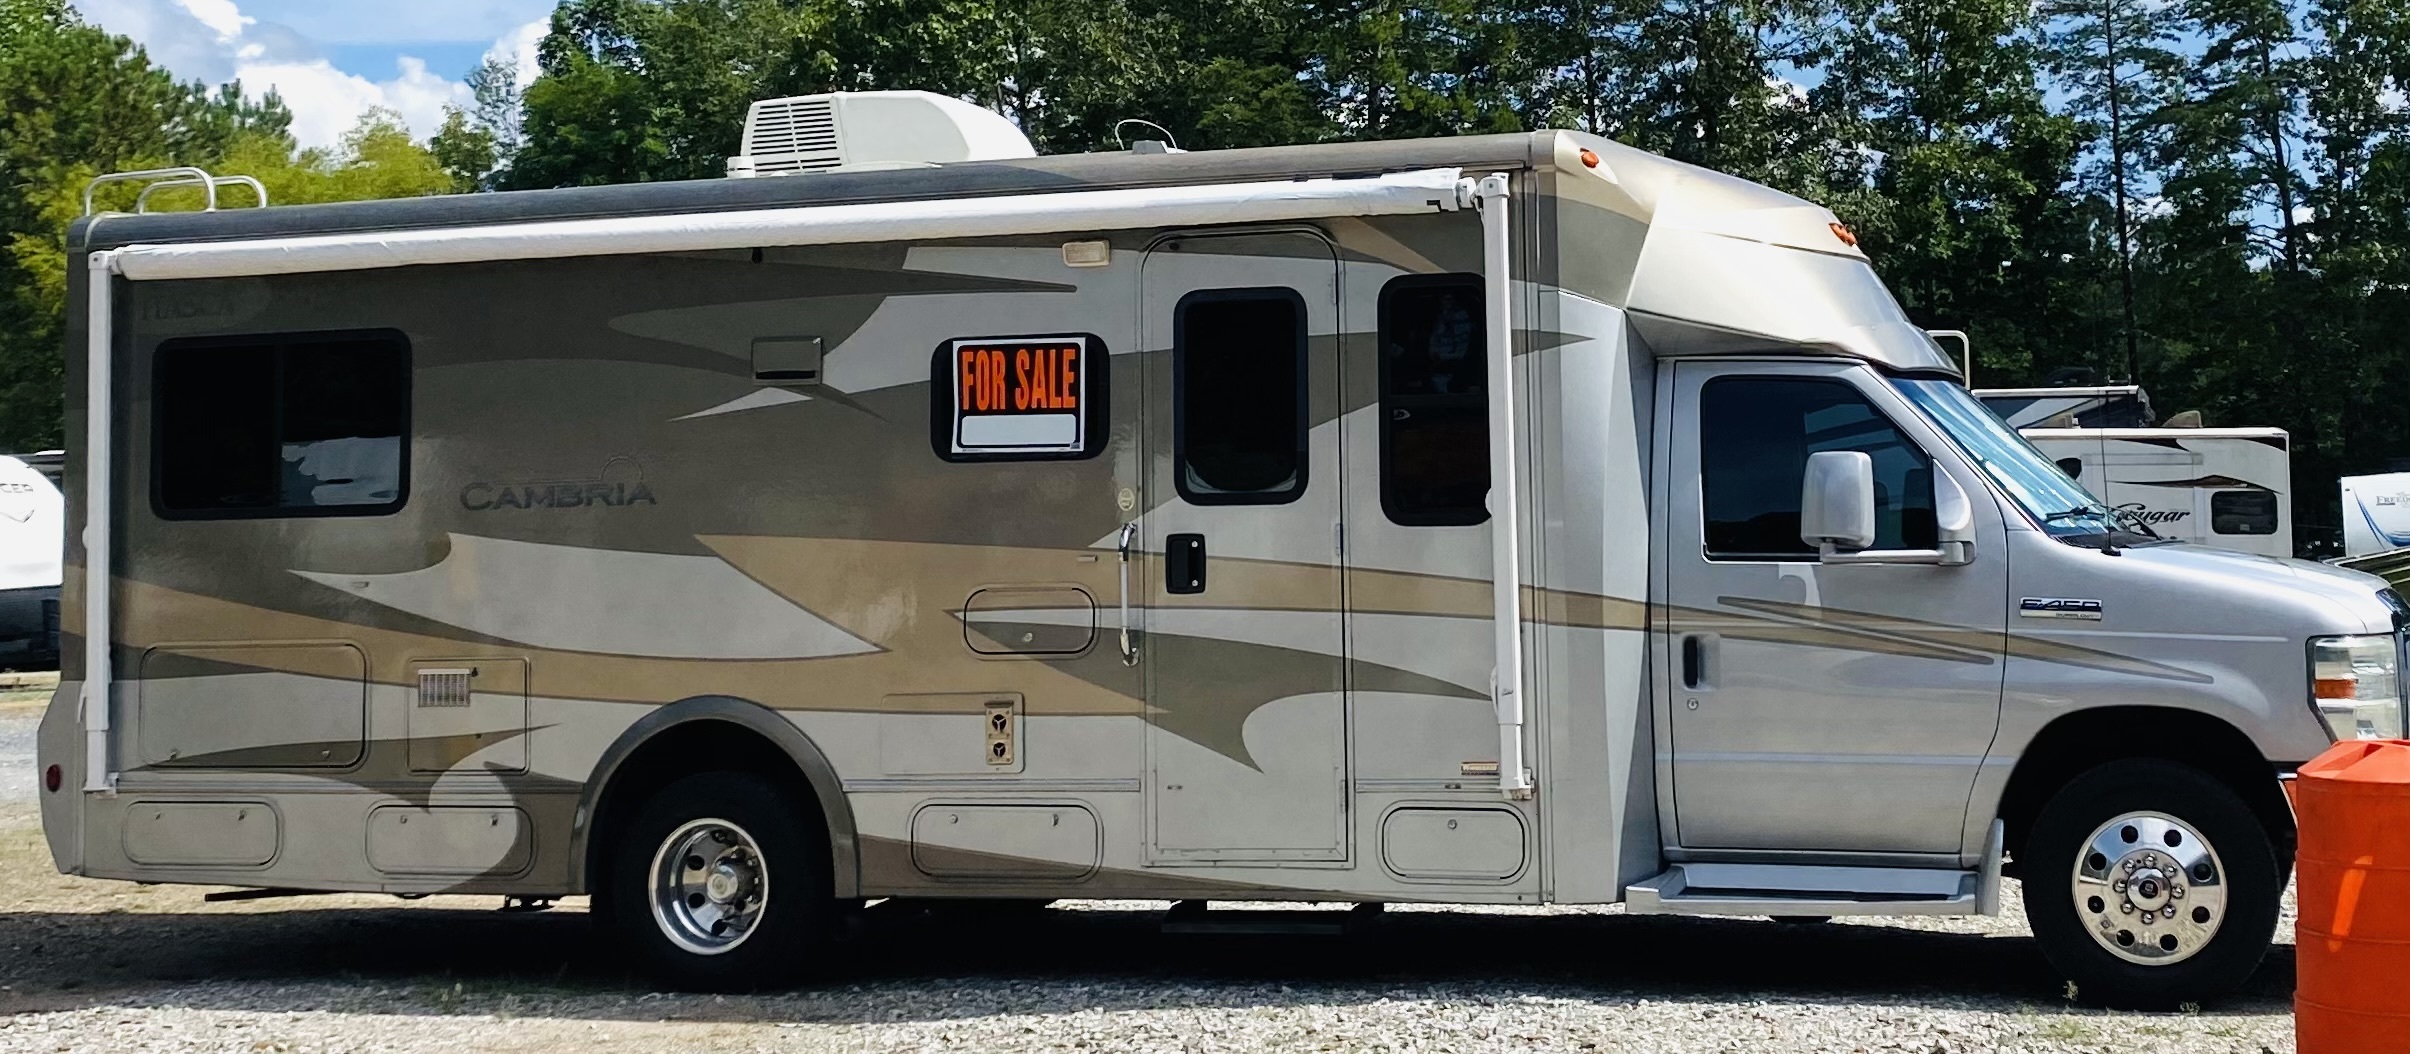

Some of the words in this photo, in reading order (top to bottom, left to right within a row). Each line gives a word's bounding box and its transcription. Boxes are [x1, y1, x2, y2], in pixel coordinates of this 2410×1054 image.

[961, 349, 1006, 411] FOR
[1015, 348, 1076, 410] SALE
[459, 481, 657, 511] CAMBRIA
